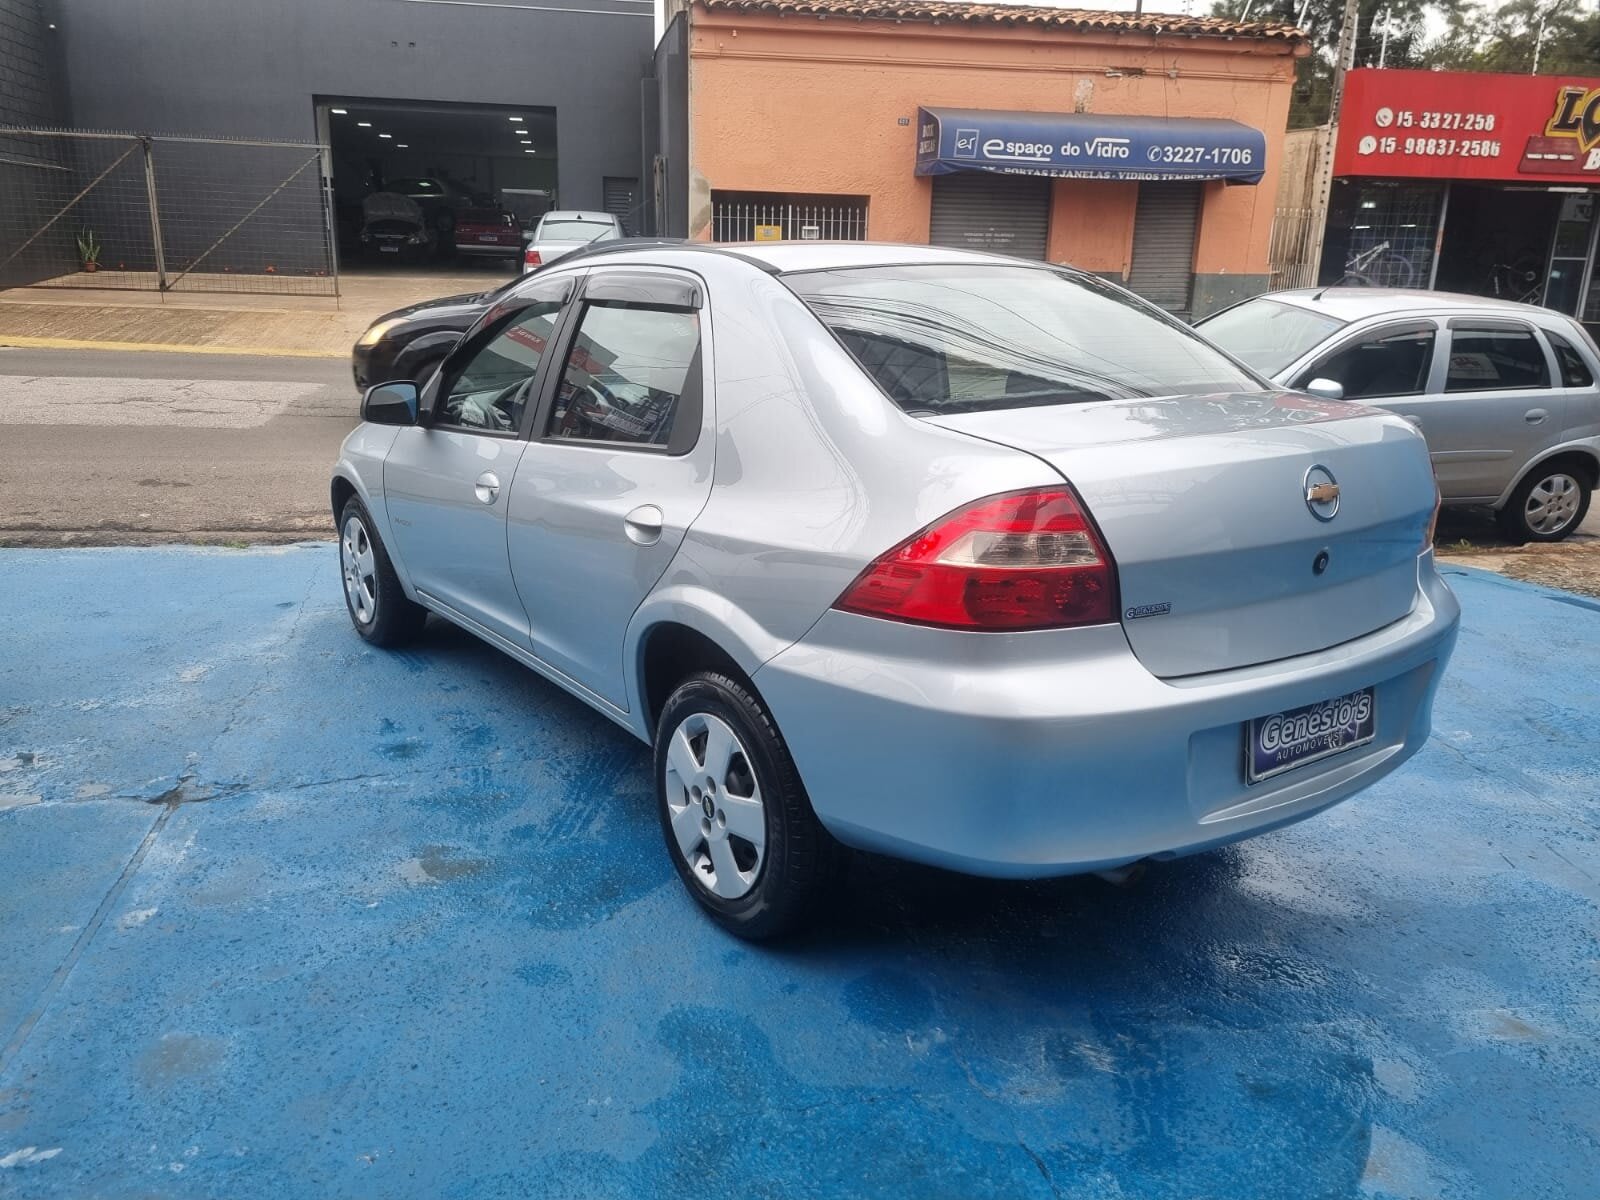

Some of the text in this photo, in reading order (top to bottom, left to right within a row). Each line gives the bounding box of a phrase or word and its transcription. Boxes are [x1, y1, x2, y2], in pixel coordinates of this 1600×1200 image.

[983, 137, 1130, 161] espaço do Vidro
[1163, 146, 1252, 165] 3227-1706
[1050, 169, 1058, 178] E
[1059, 169, 1111, 179] JANELAS
[1119, 171, 1160, 181] VIDROS
